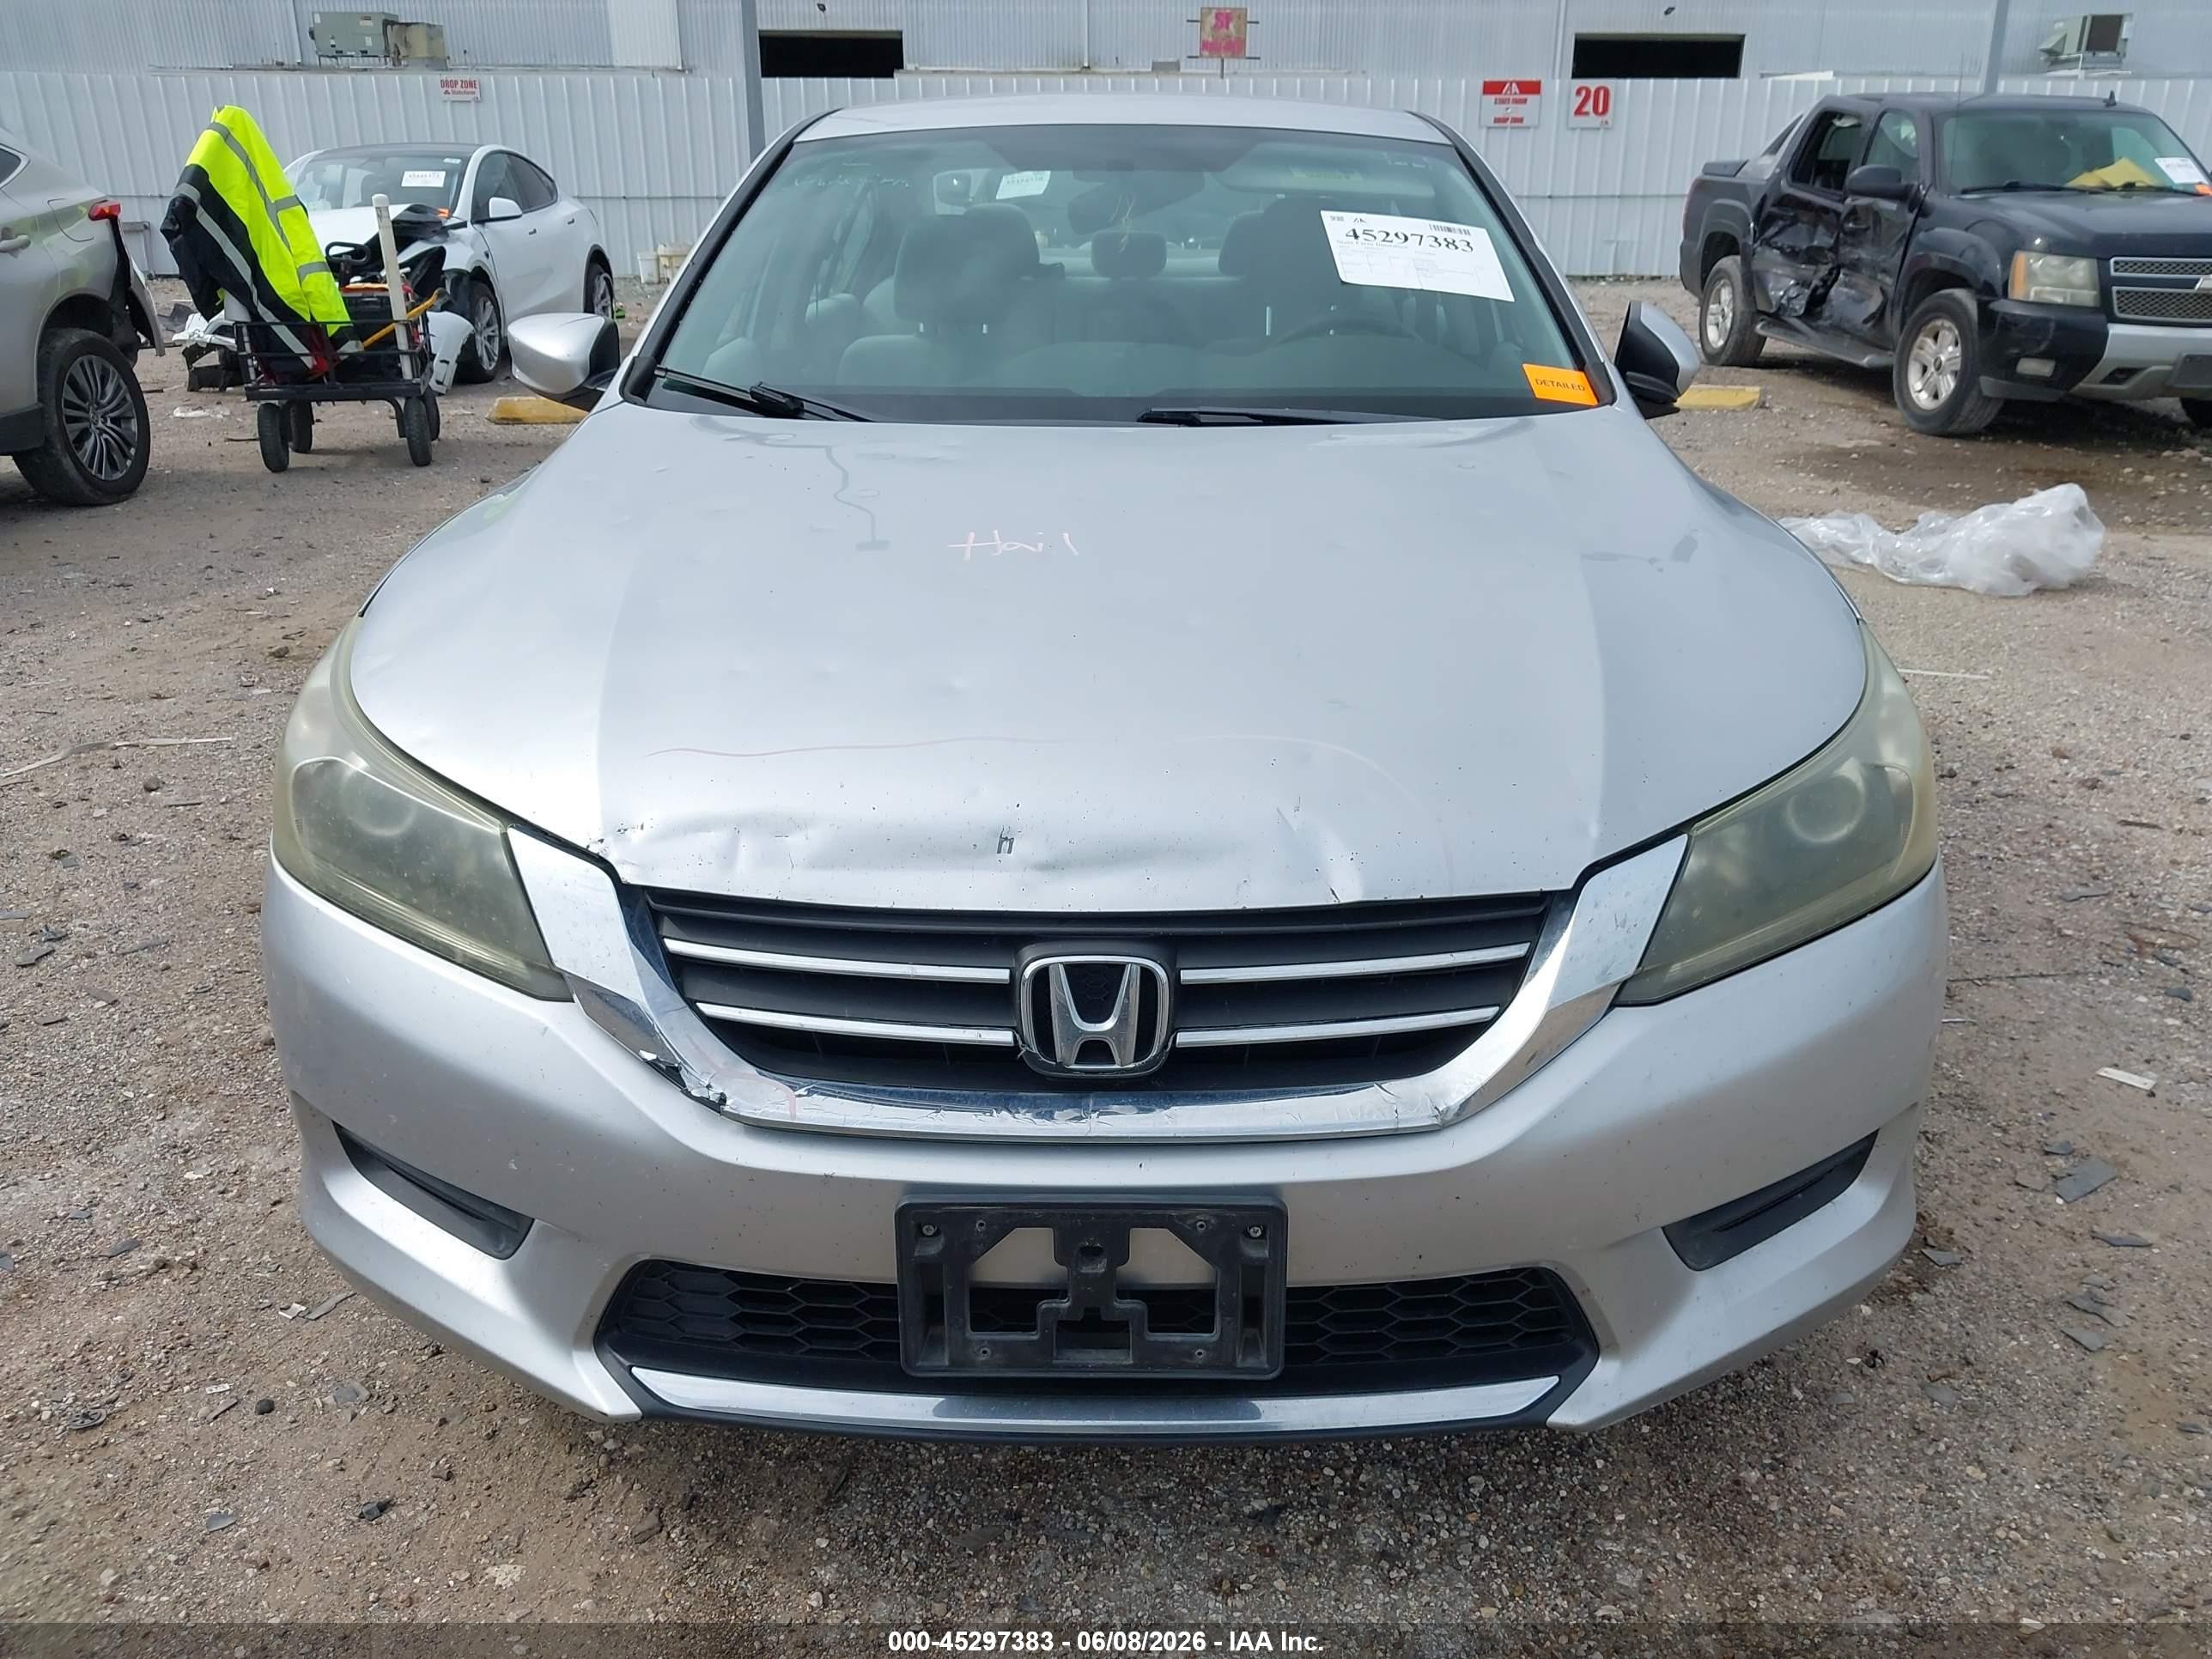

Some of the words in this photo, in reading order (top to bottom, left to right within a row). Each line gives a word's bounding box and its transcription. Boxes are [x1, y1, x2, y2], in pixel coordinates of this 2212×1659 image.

[441, 79, 459, 88] DROP
[460, 79, 477, 89] ZONE
[1574, 86, 1610, 116] 20
[1346, 228, 1474, 253] 45297383
[1534, 378, 1585, 392] DETAILED
[946, 529, 1079, 561] Hail
